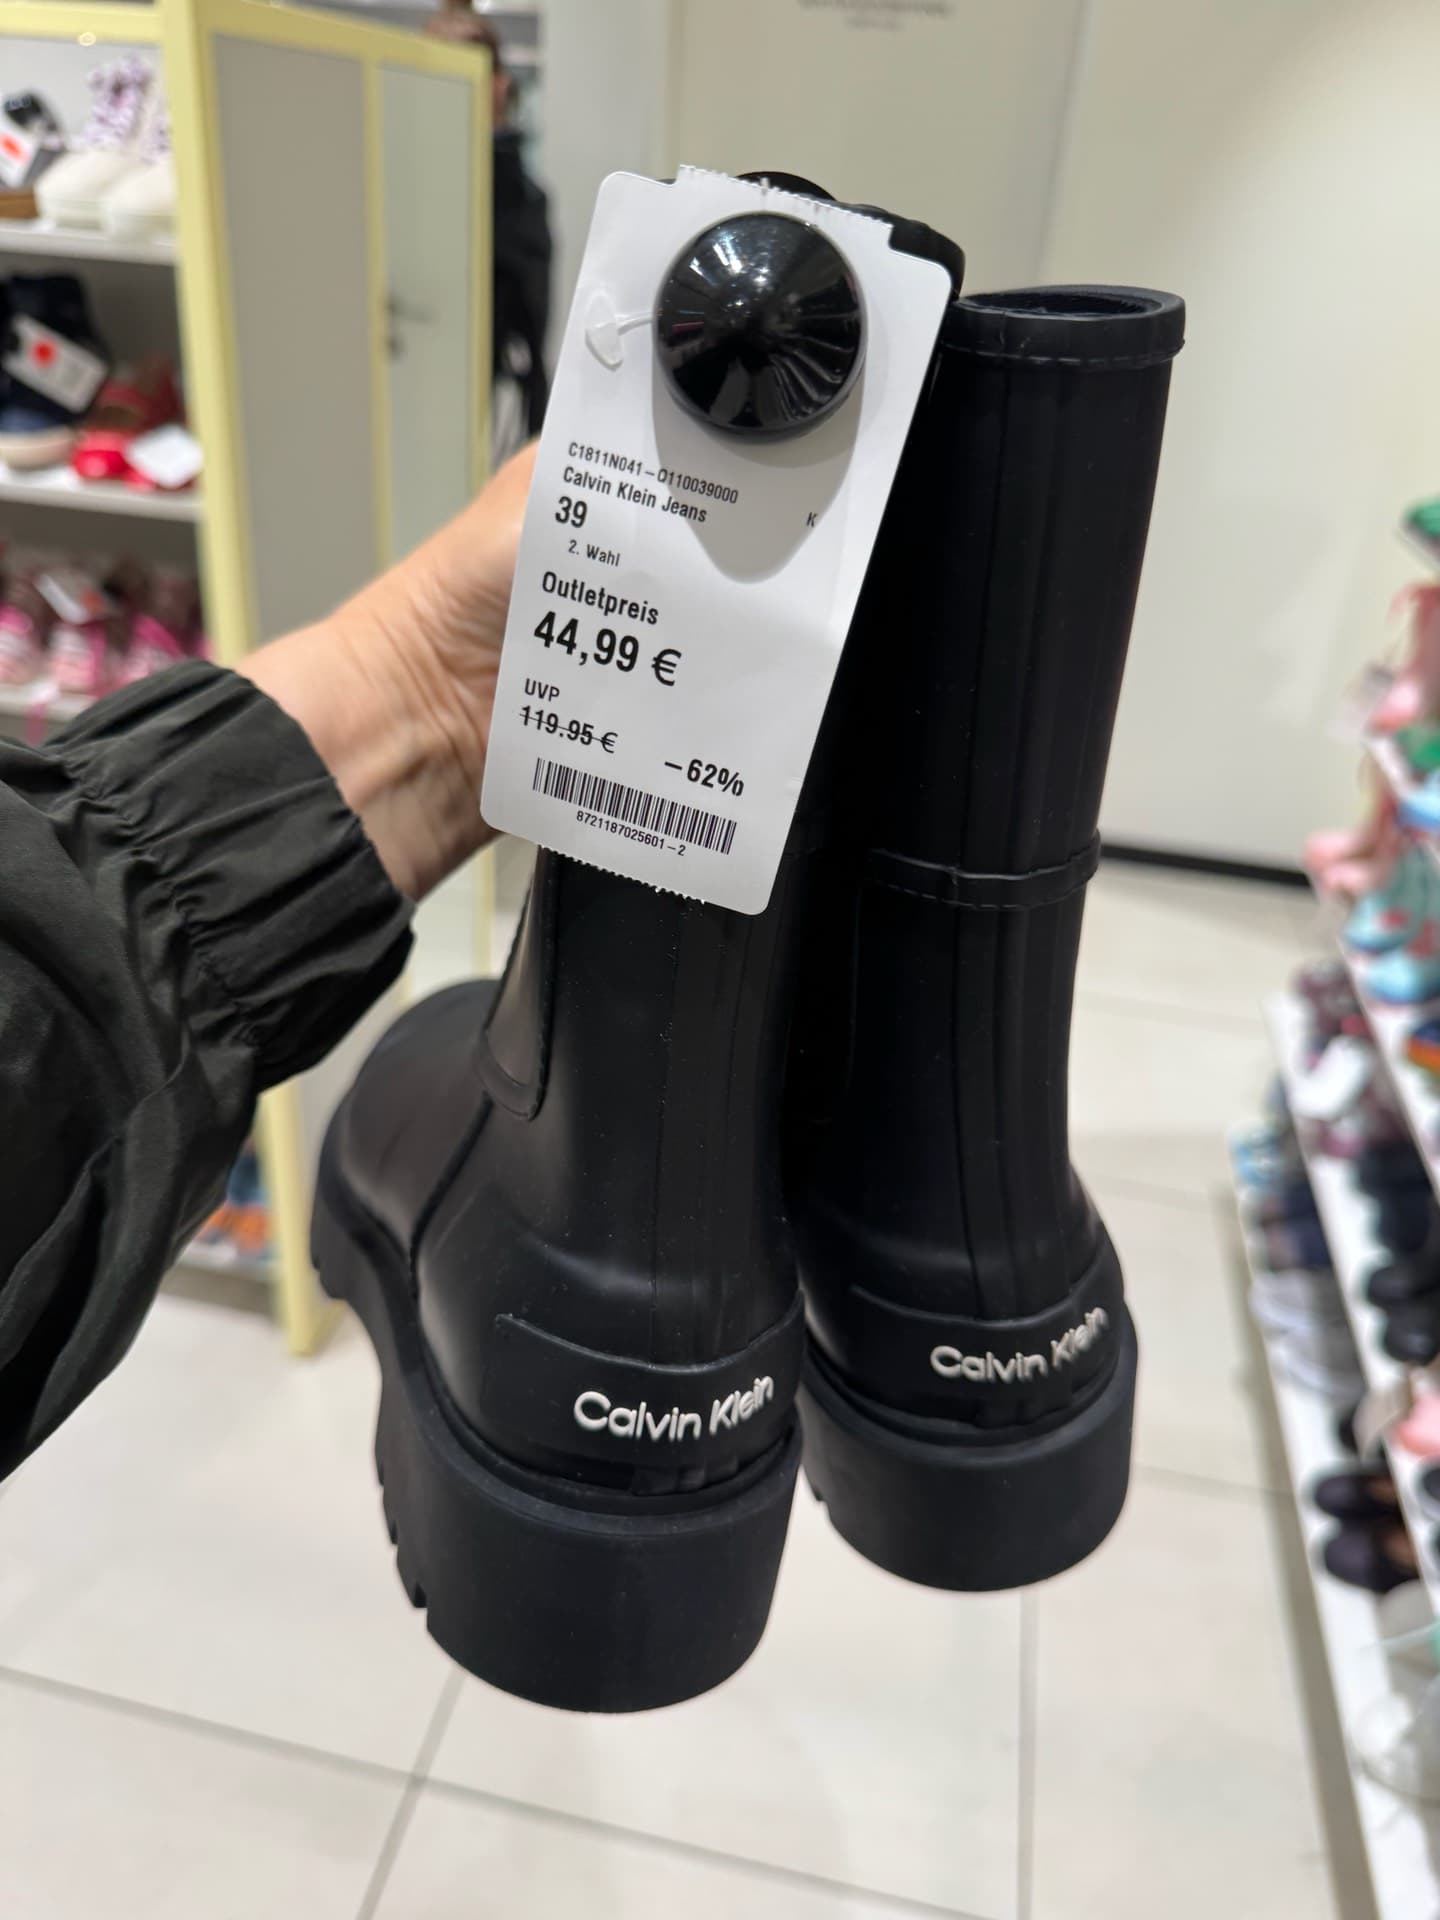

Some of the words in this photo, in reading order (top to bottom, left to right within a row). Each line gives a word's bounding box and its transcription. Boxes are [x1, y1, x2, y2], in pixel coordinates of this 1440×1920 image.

[555, 496, 588, 528] 39
[563, 466, 612, 496] Calvin
[616, 482, 657, 508] Klein
[661, 496, 707, 523] Jeans
[806, 511, 818, 527] K
[568, 539, 580, 555] 2.
[586, 543, 621, 567] Wahl
[542, 571, 660, 626] Outletpreis
[533, 611, 639, 672] 44,99
[651, 648, 682, 687] €
[524, 678, 560, 702] UVP
[520, 705, 595, 746] 119.95
[600, 732, 619, 753] €
[930, 1345, 1048, 1383] Calvin
[1050, 1306, 1110, 1370] Klein
[573, 1391, 701, 1442] Calvin
[708, 1375, 774, 1435] Klein
